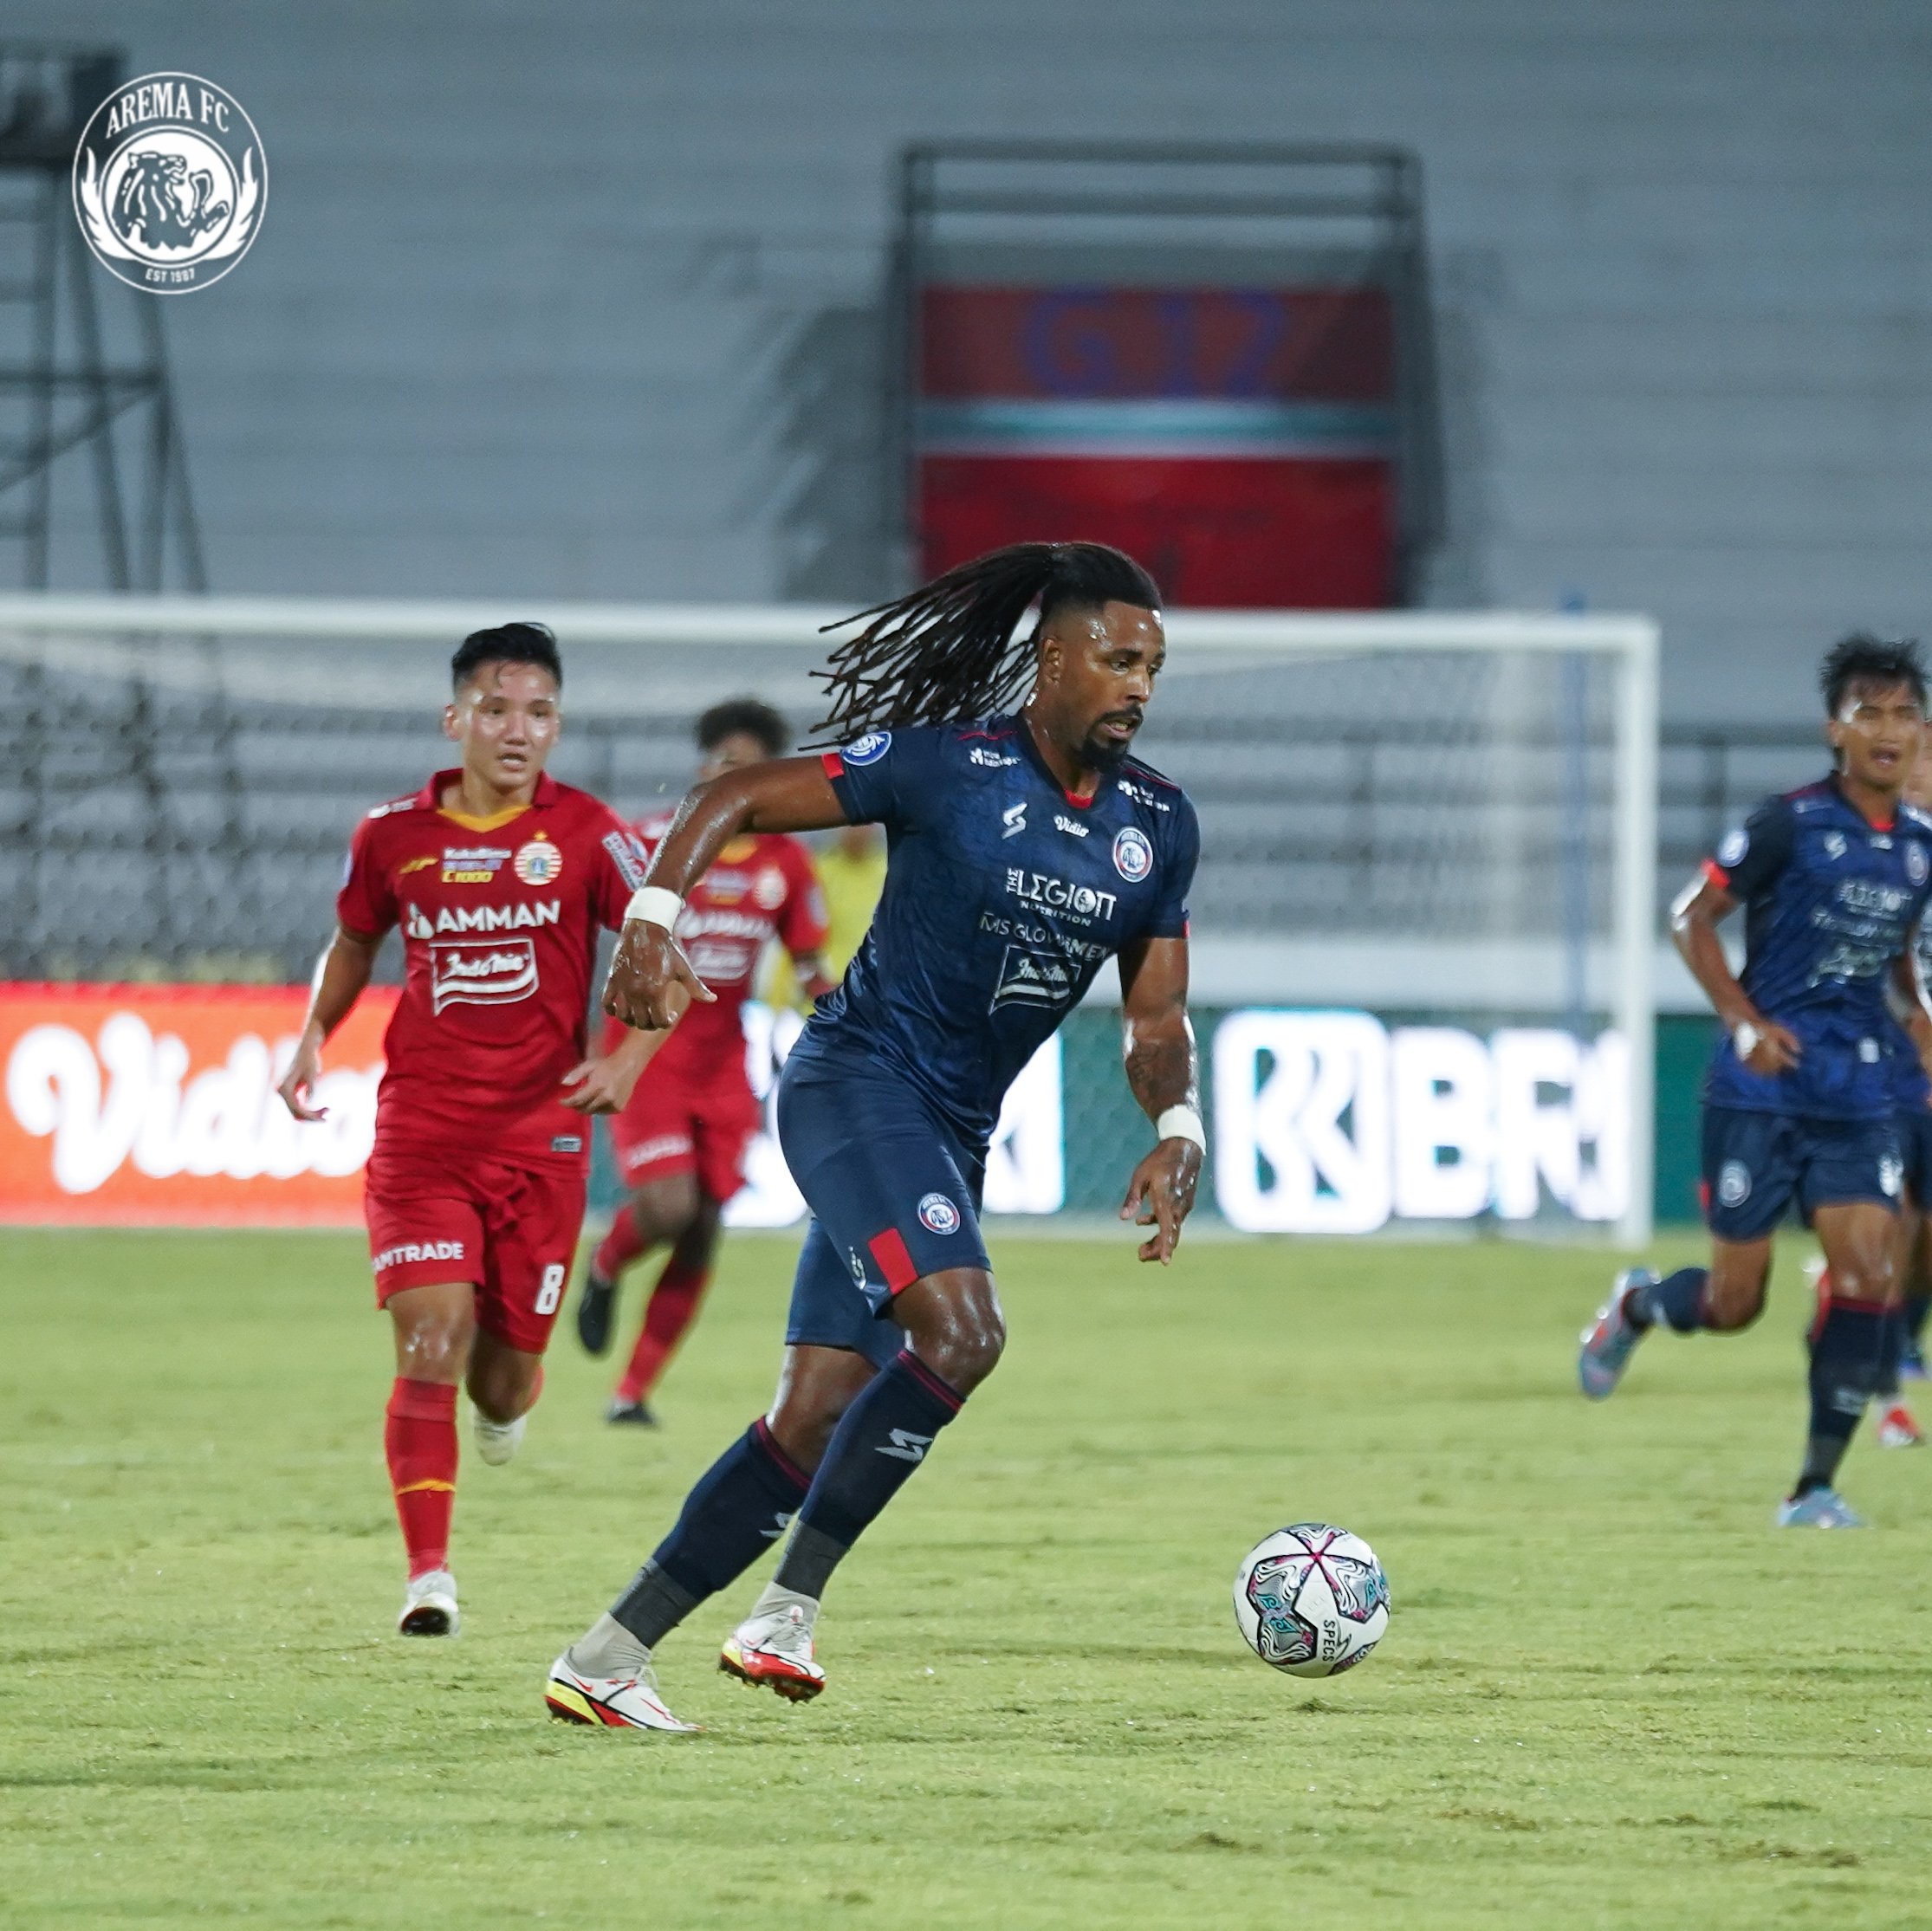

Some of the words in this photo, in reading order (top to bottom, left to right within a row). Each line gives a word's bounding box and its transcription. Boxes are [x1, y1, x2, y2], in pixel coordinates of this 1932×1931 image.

[1054, 814, 1090, 838] Vidio
[436, 899, 561, 934] AMMAN
[1016, 869, 1117, 921] LEGION
[7, 1011, 384, 1194] Vidio
[535, 1263, 566, 1316] 8
[1323, 1618, 1335, 1662] SPECS
